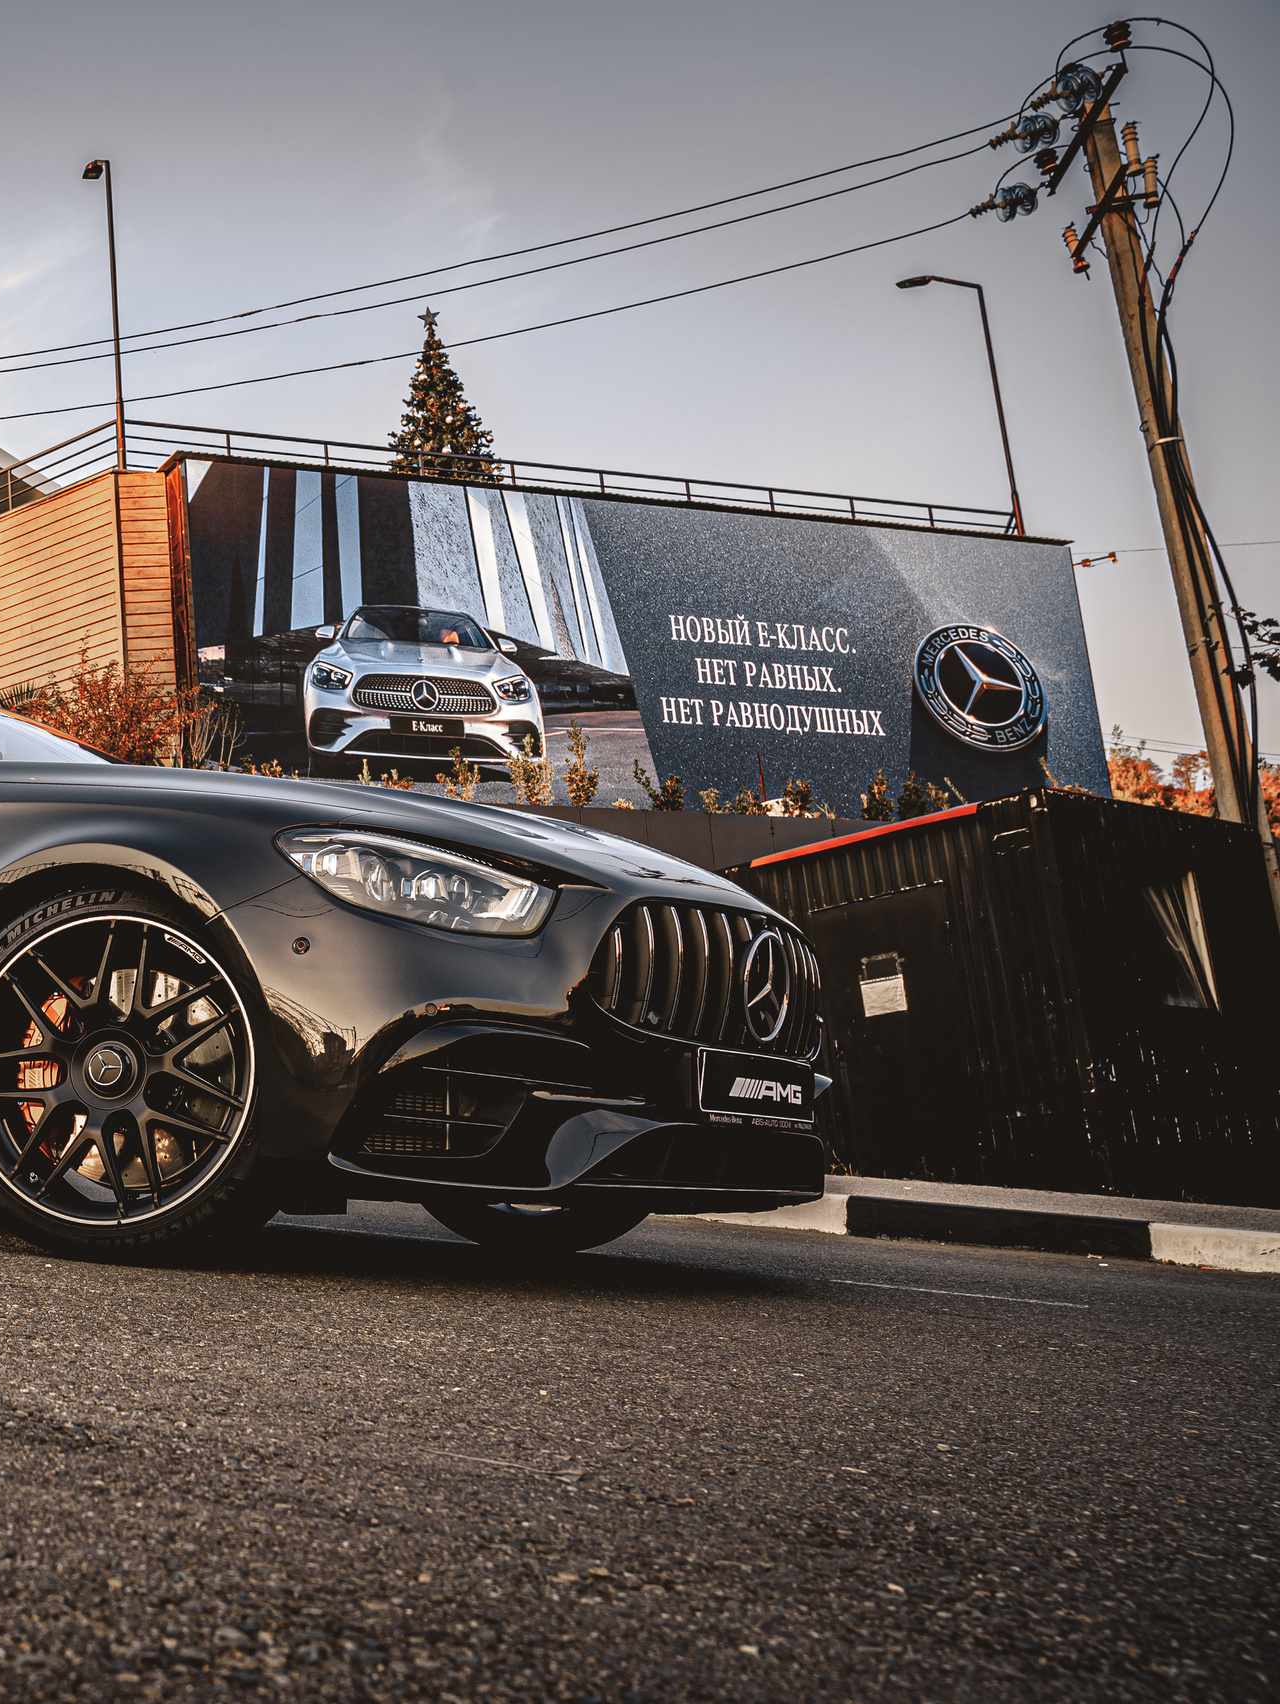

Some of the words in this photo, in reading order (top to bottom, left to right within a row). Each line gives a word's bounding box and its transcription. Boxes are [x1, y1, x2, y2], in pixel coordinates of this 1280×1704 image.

[669, 614, 751, 646] НОВЫЙ
[756, 621, 857, 654] Е-КЛАСС.
[922, 628, 989, 666] MERCEDES
[695, 658, 737, 686] НЕТ
[743, 661, 842, 693] РАВНЫХ.
[660, 697, 704, 725] НЕТ
[710, 700, 886, 737] РАВНОДУШНЫХ
[995, 718, 1033, 743] BENZ
[6, 891, 116, 944] MICHELIN
[176, 942, 203, 963] AMG
[754, 1080, 802, 1105] AMG
